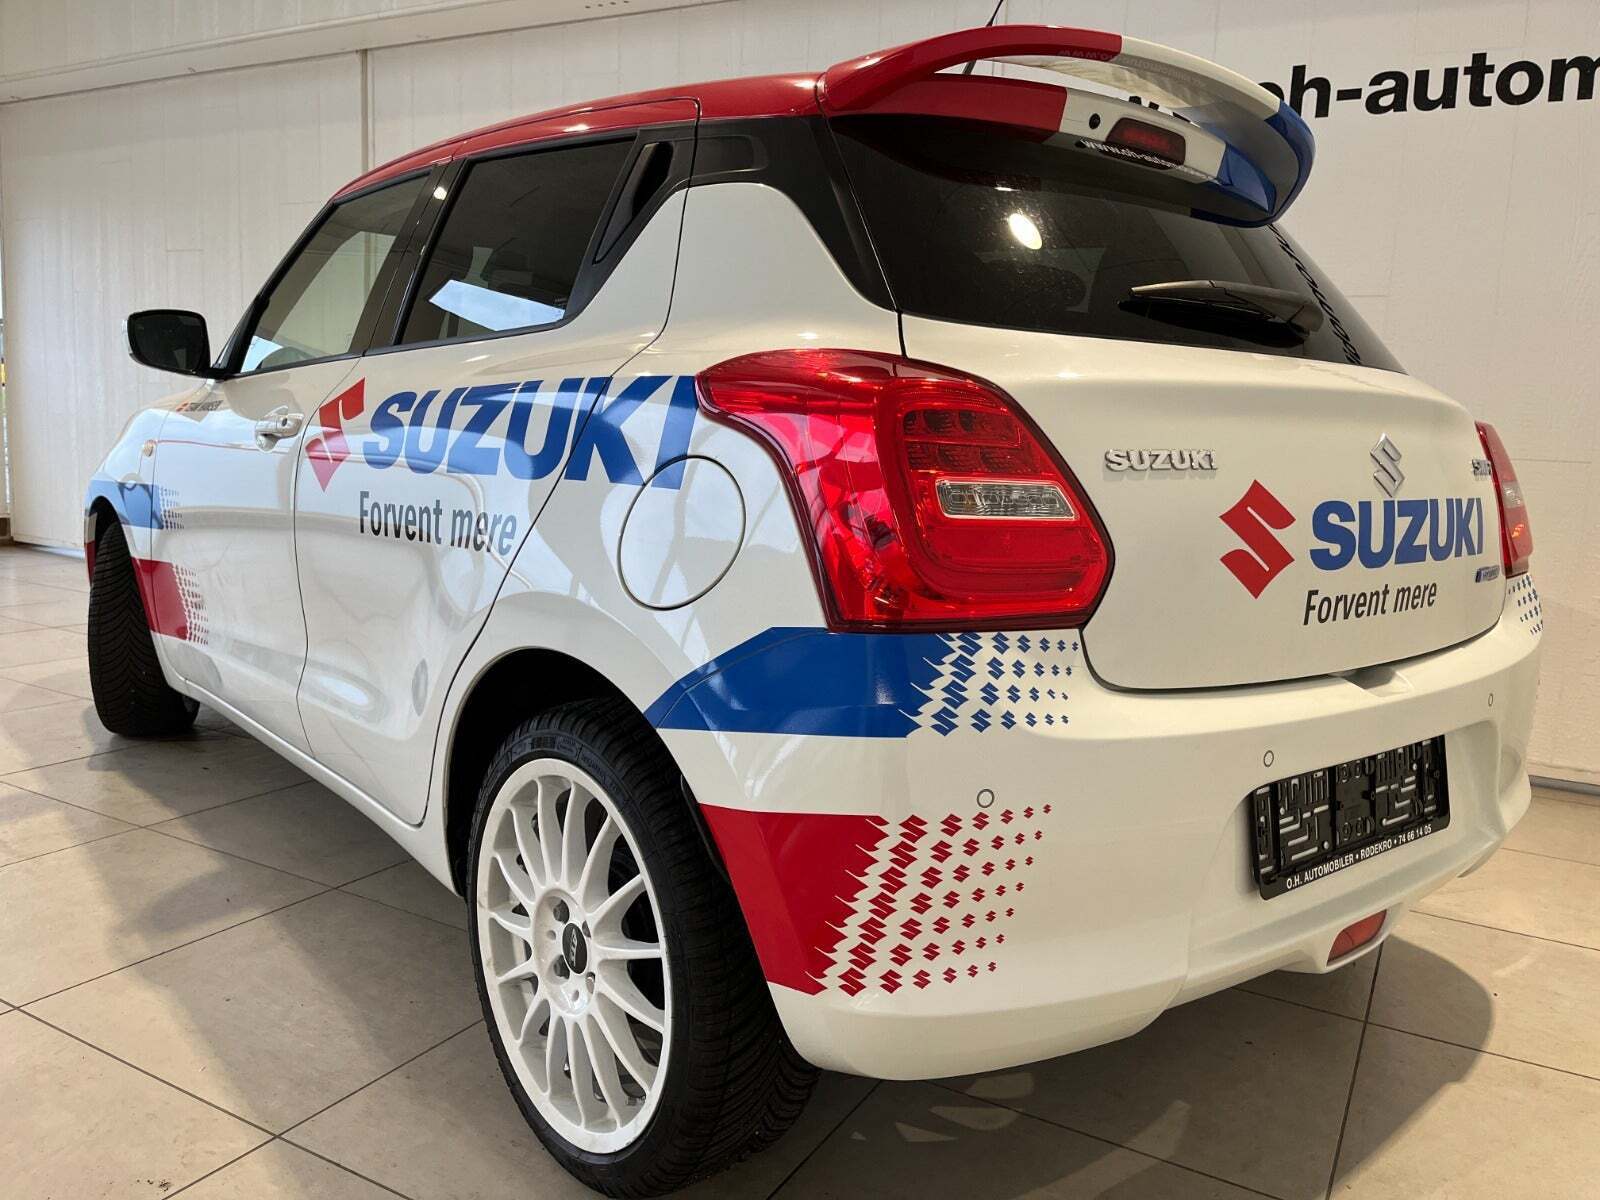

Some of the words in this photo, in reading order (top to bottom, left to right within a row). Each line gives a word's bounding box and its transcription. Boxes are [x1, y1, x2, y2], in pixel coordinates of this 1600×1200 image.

[362, 375, 698, 490] SUZUKI
[1105, 448, 1218, 471] SUZUKI
[359, 490, 442, 545] Forvent
[450, 508, 517, 556] mere
[1309, 497, 1483, 571] SUZUKI
[1303, 584, 1388, 626] Forvent
[1392, 582, 1438, 613] mere
[1304, 853, 1354, 883] AUTOMOBILER
